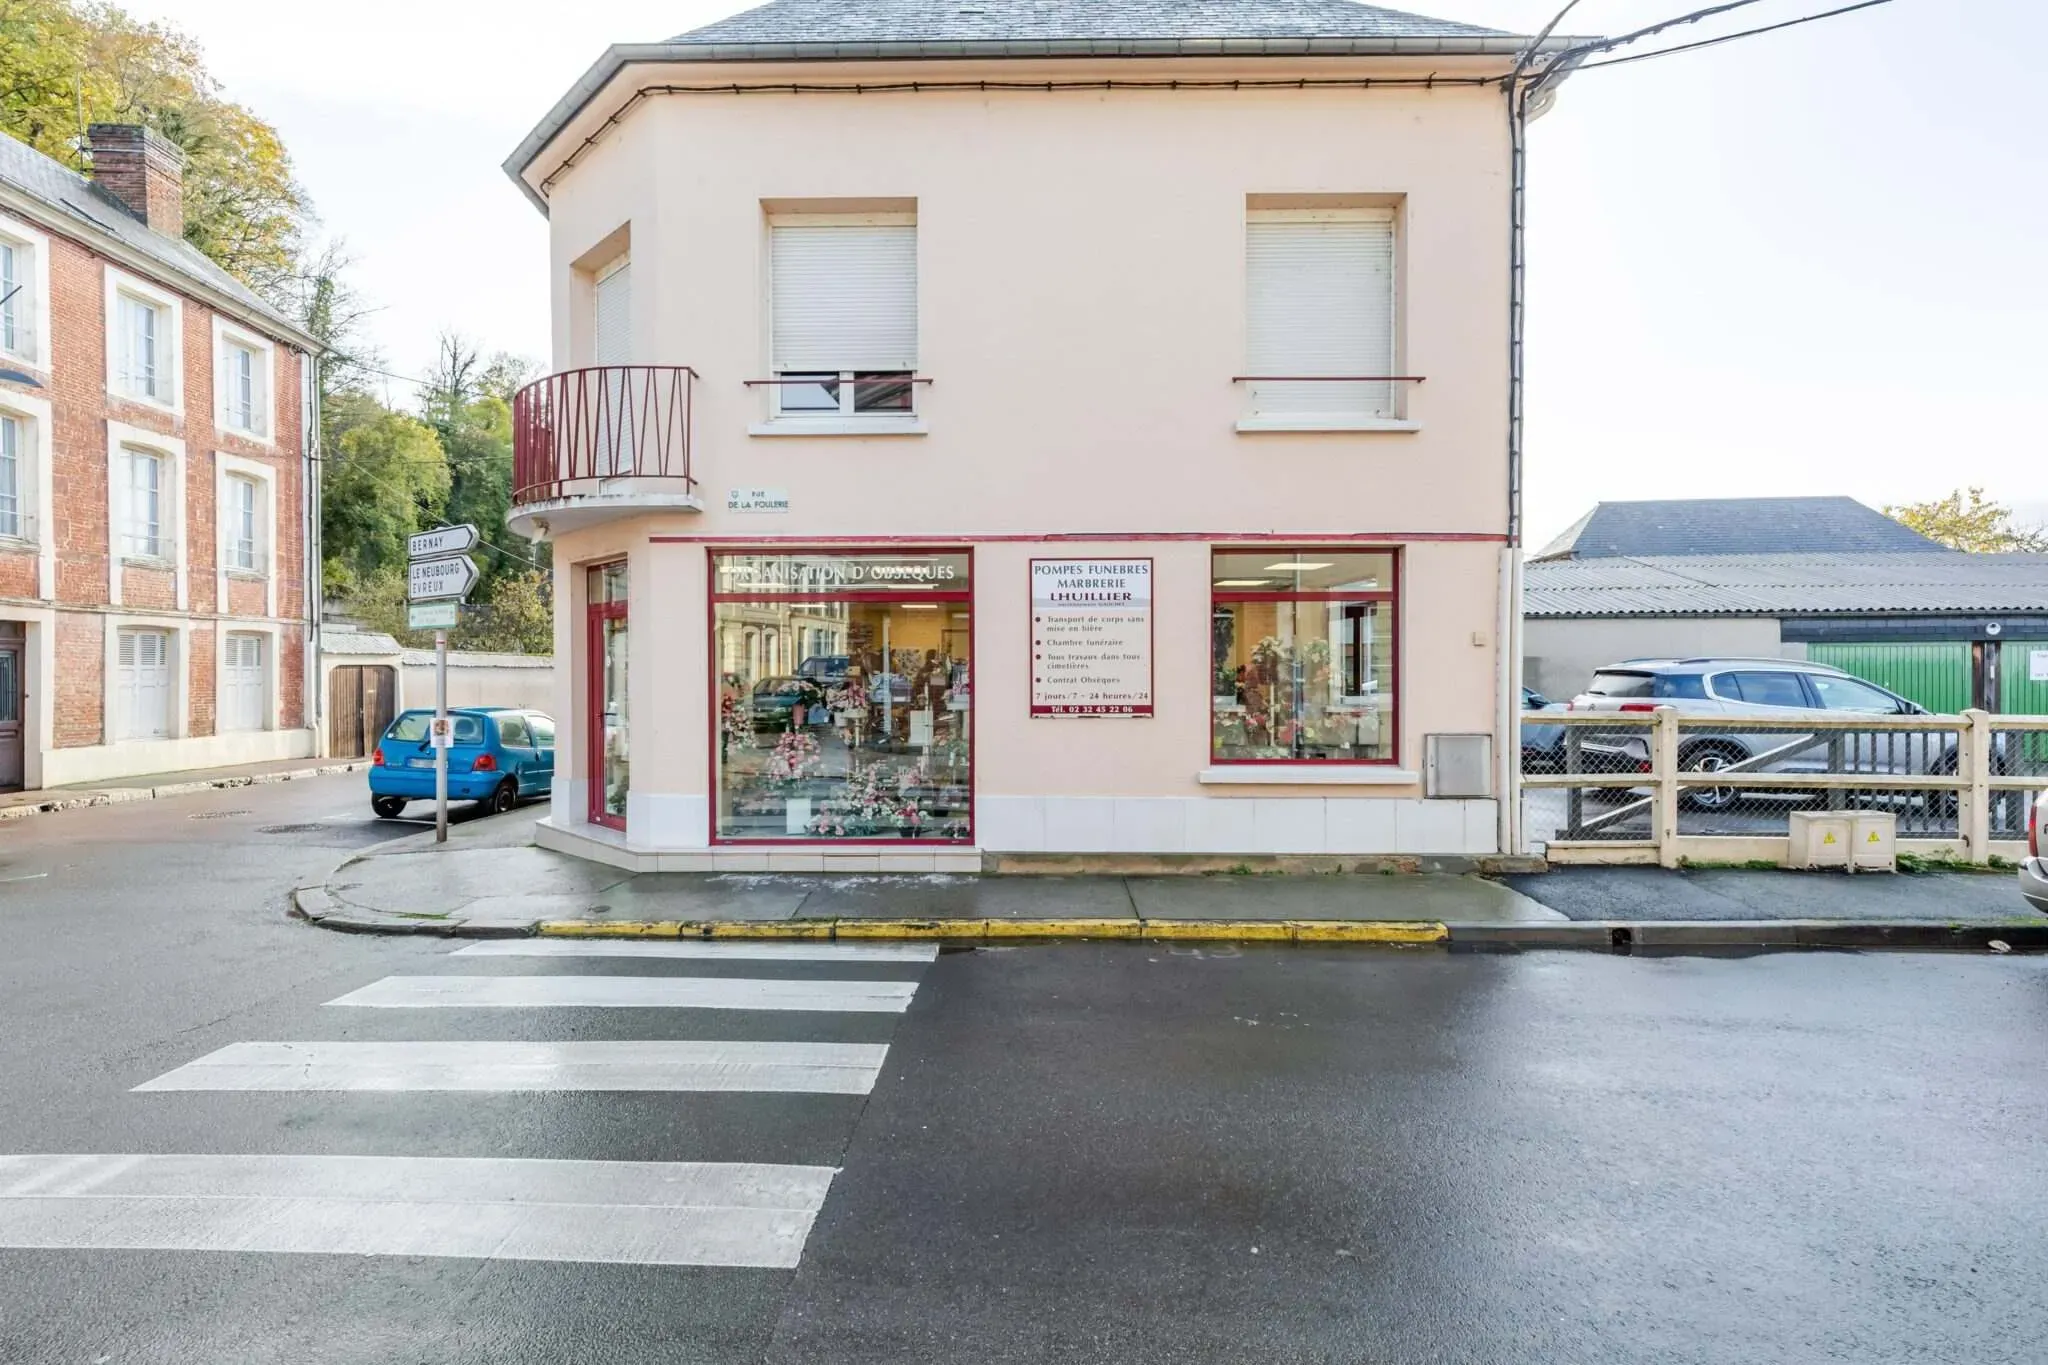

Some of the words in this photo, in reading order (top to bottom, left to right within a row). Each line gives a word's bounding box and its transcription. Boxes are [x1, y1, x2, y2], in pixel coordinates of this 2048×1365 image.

[728, 501, 738, 509] DE
[754, 500, 789, 508] FOULERIE
[412, 536, 444, 552] BERNAY
[412, 568, 420, 580] LE
[422, 563, 460, 578] NEUBOURG
[1034, 565, 1083, 575] POMPES
[1088, 565, 1148, 575] FUNEBRES
[412, 581, 444, 594] EVREUX
[1057, 579, 1126, 589] MARBRERIE
[1050, 592, 1133, 601] LHUILLIER
[1047, 615, 1085, 624] Transport
[1101, 616, 1124, 624] corps
[1101, 652, 1120, 660] dans
[1080, 676, 1120, 685] Obsèques
[1044, 692, 1078, 701] jours/7
